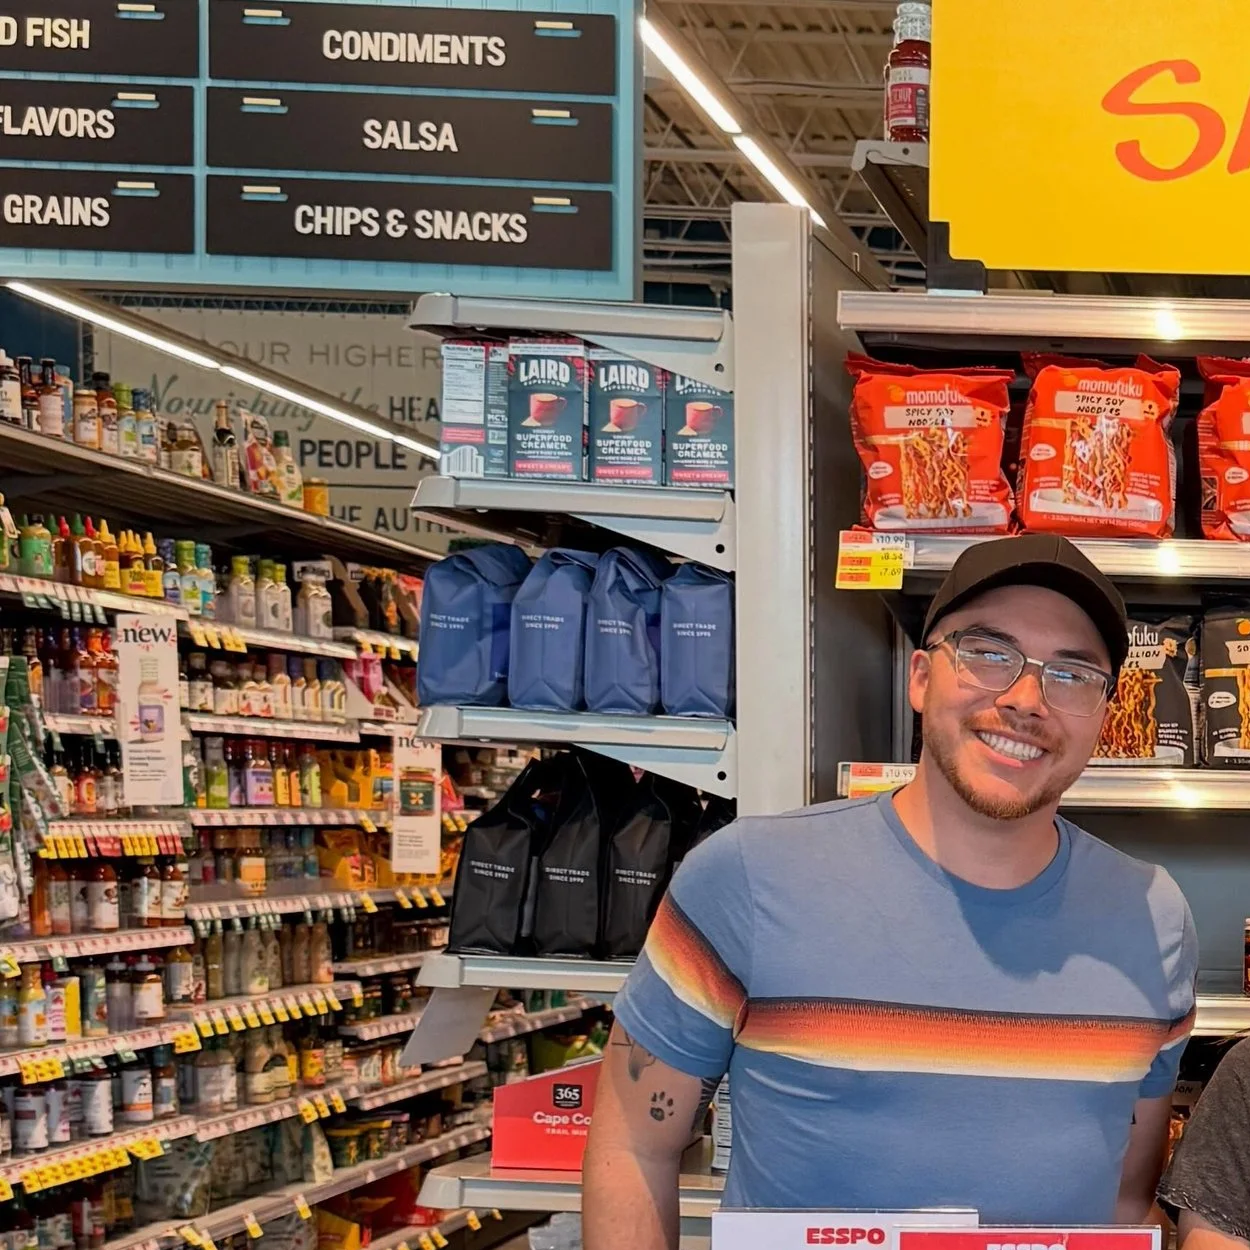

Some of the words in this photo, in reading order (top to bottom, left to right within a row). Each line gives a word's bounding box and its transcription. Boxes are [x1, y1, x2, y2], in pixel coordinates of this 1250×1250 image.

[26, 17, 91, 49] FISH
[322, 30, 506, 67] CONDIMENTS
[0, 105, 115, 139] LAVORS
[363, 119, 458, 153] SALSA
[3, 194, 110, 227] GRAINS
[294, 205, 380, 238] CHIPS
[386, 210, 407, 237] &
[414, 211, 528, 244] SNACKS
[311, 343, 441, 369] HIGHER
[520, 359, 570, 383] LAIRD
[599, 364, 650, 389] LAIRD
[1078, 377, 1143, 397] momofuku
[1075, 395, 1101, 404] SPICY
[1105, 397, 1125, 406] SOY
[906, 408, 933, 416] SPICY
[516, 433, 572, 442] SUPERFOOD
[521, 441, 567, 450] CREAMER
[597, 440, 652, 449] SUPERFOOD
[301, 439, 404, 470] PEOPLE
[602, 448, 648, 456] CREAMER
[672, 443, 728, 451] SUPERFOOD
[678, 451, 725, 459] CREAMER
[123, 627, 171, 644] new
[555, 1087, 579, 1100] 365
[533, 1111, 570, 1126] Cape
[806, 1227, 885, 1245] ESSPO
